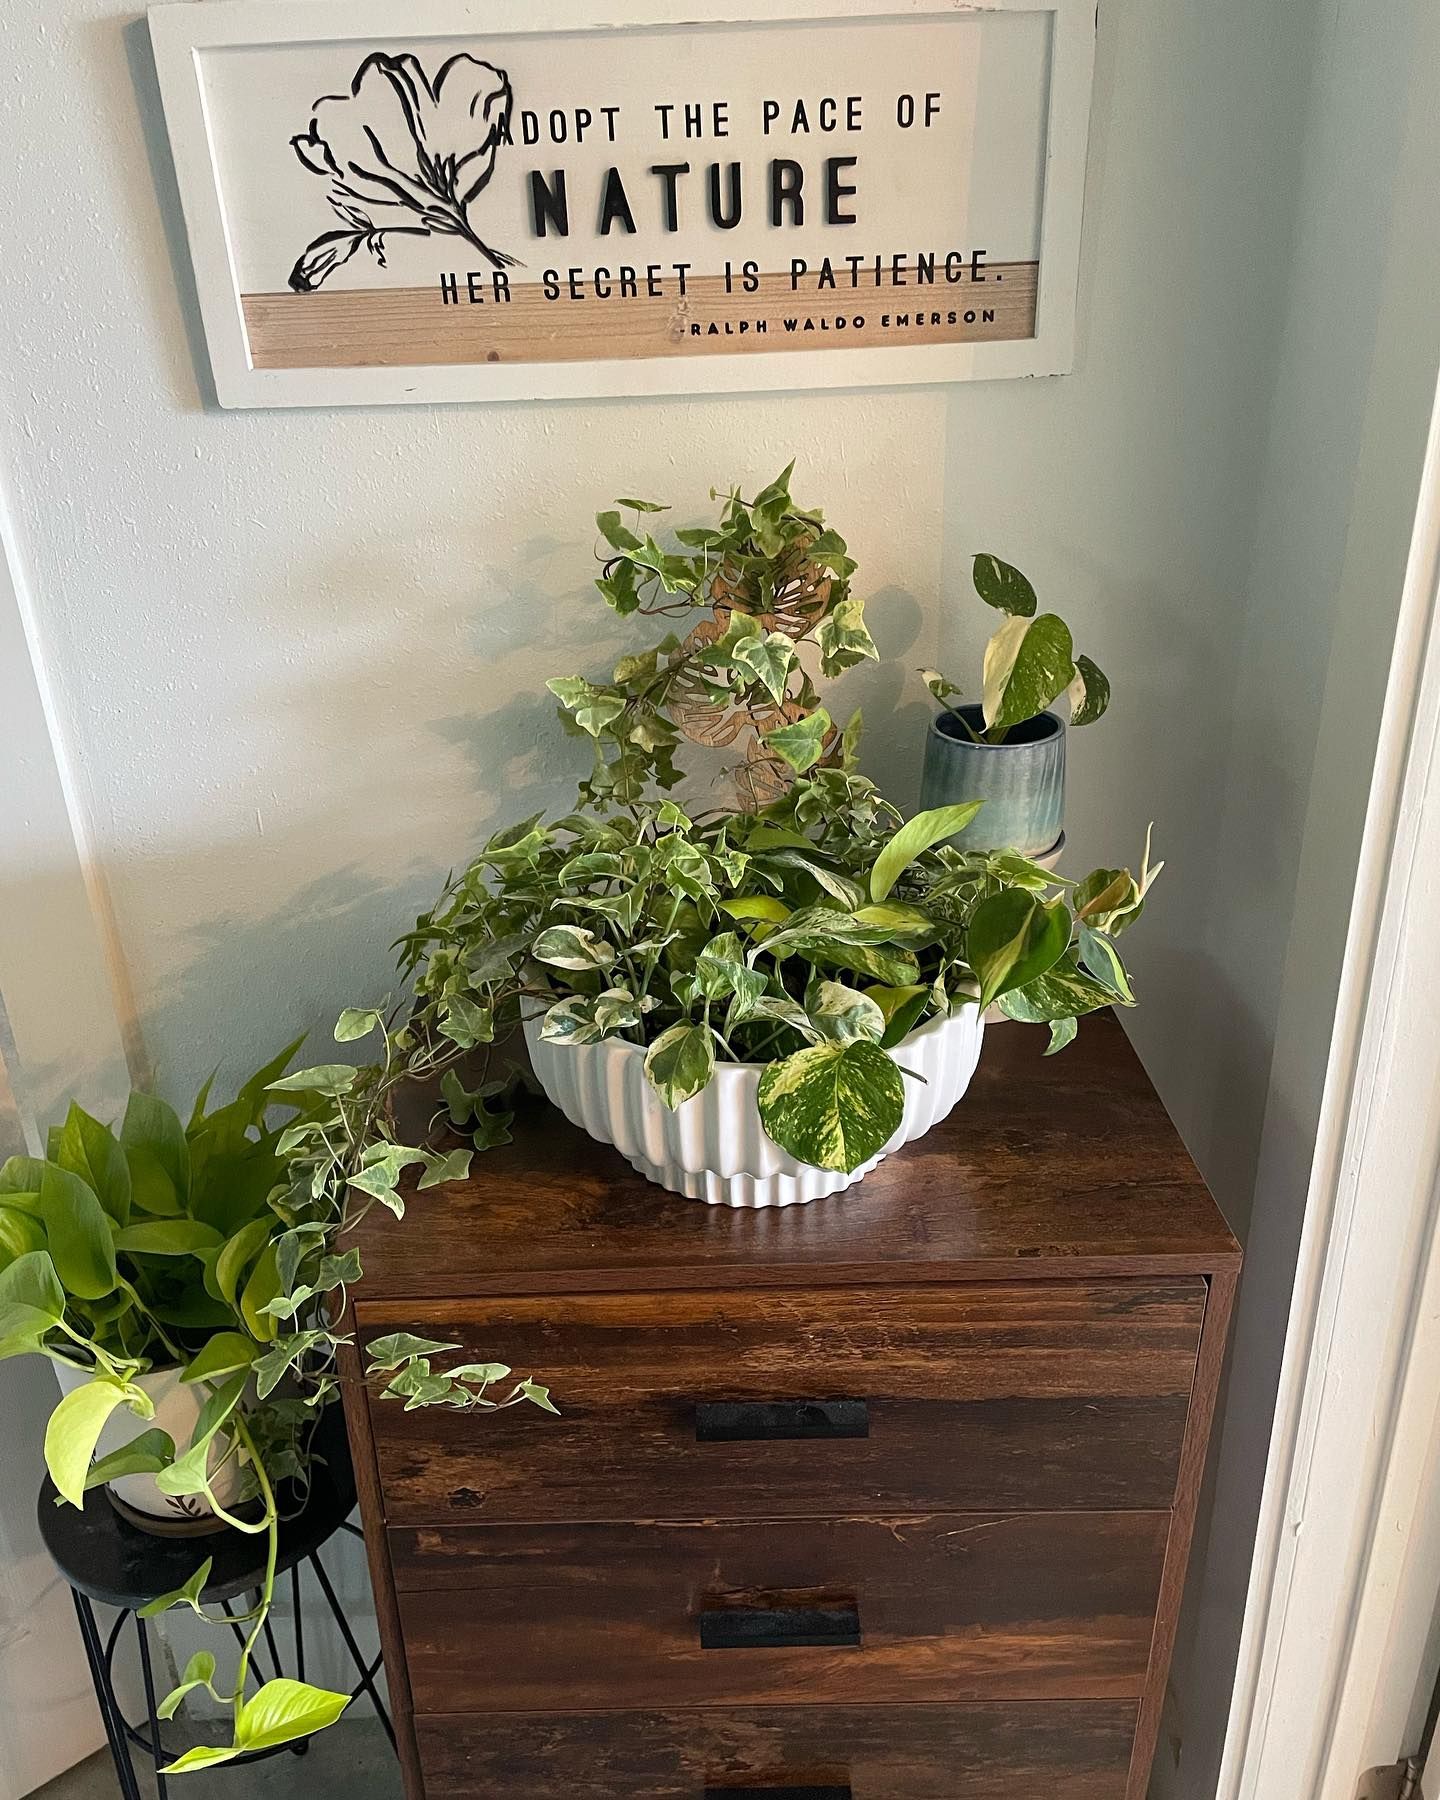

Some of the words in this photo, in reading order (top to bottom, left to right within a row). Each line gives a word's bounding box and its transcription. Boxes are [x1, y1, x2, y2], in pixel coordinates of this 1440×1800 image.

[495, 106, 620, 146] ADOPT
[654, 102, 729, 140] THE
[763, 96, 862, 135] PACE
[896, 92, 941, 129] OF
[531, 156, 858, 238] NATURE
[440, 271, 511, 305] HER
[542, 263, 692, 301] SECRET
[725, 260, 760, 294] IS
[791, 249, 1003, 291] PATIENCE.
[783, 315, 866, 333] WALDO
[880, 309, 995, 328] EMERSON
